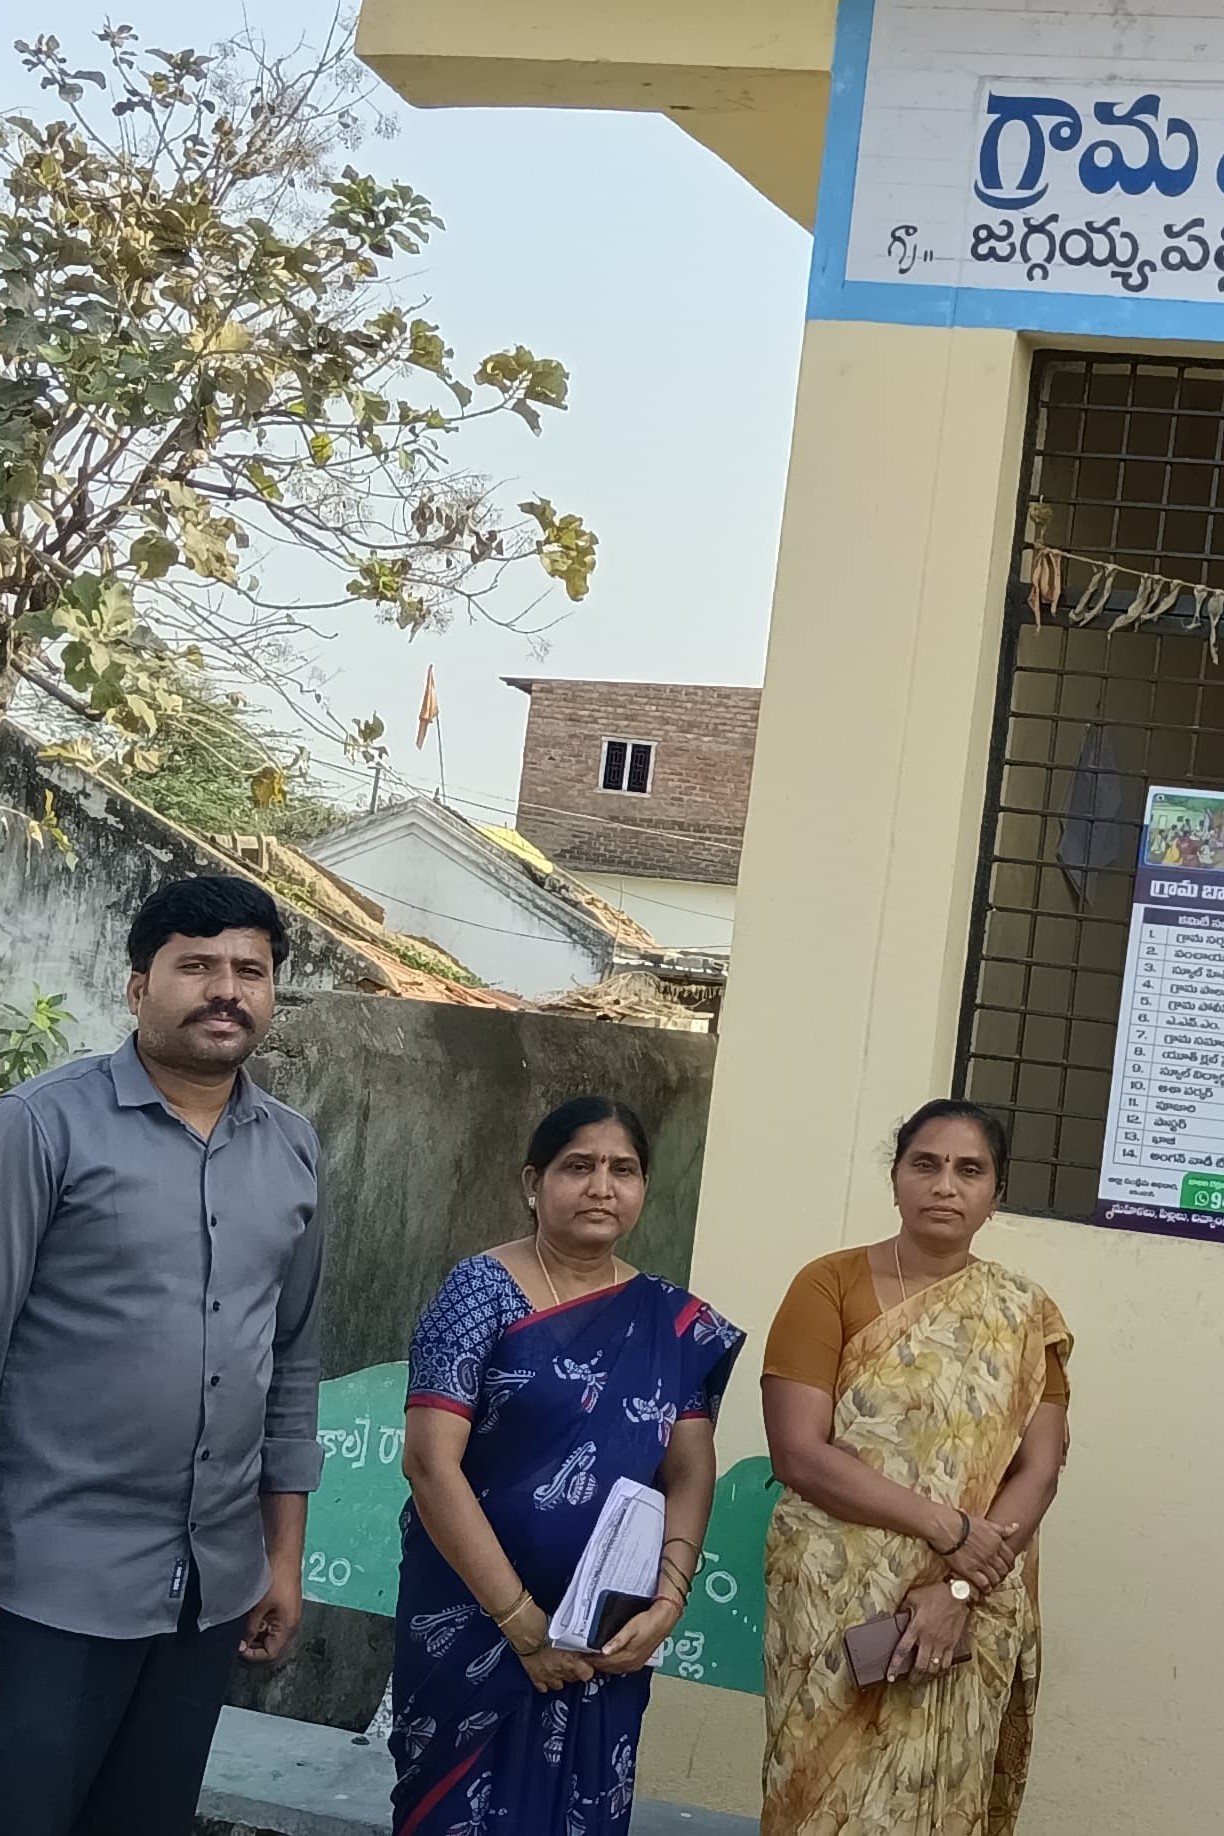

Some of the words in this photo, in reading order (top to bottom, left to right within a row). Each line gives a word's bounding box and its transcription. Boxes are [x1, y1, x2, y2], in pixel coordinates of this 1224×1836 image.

[1150, 880, 1199, 898] గ్రామ
[1176, 933, 1204, 944] గ్రామ
[1170, 984, 1198, 994] గ్రామ
[1168, 1001, 1196, 1011] గ్రామ
[1164, 1034, 1192, 1044] గ్రామ
